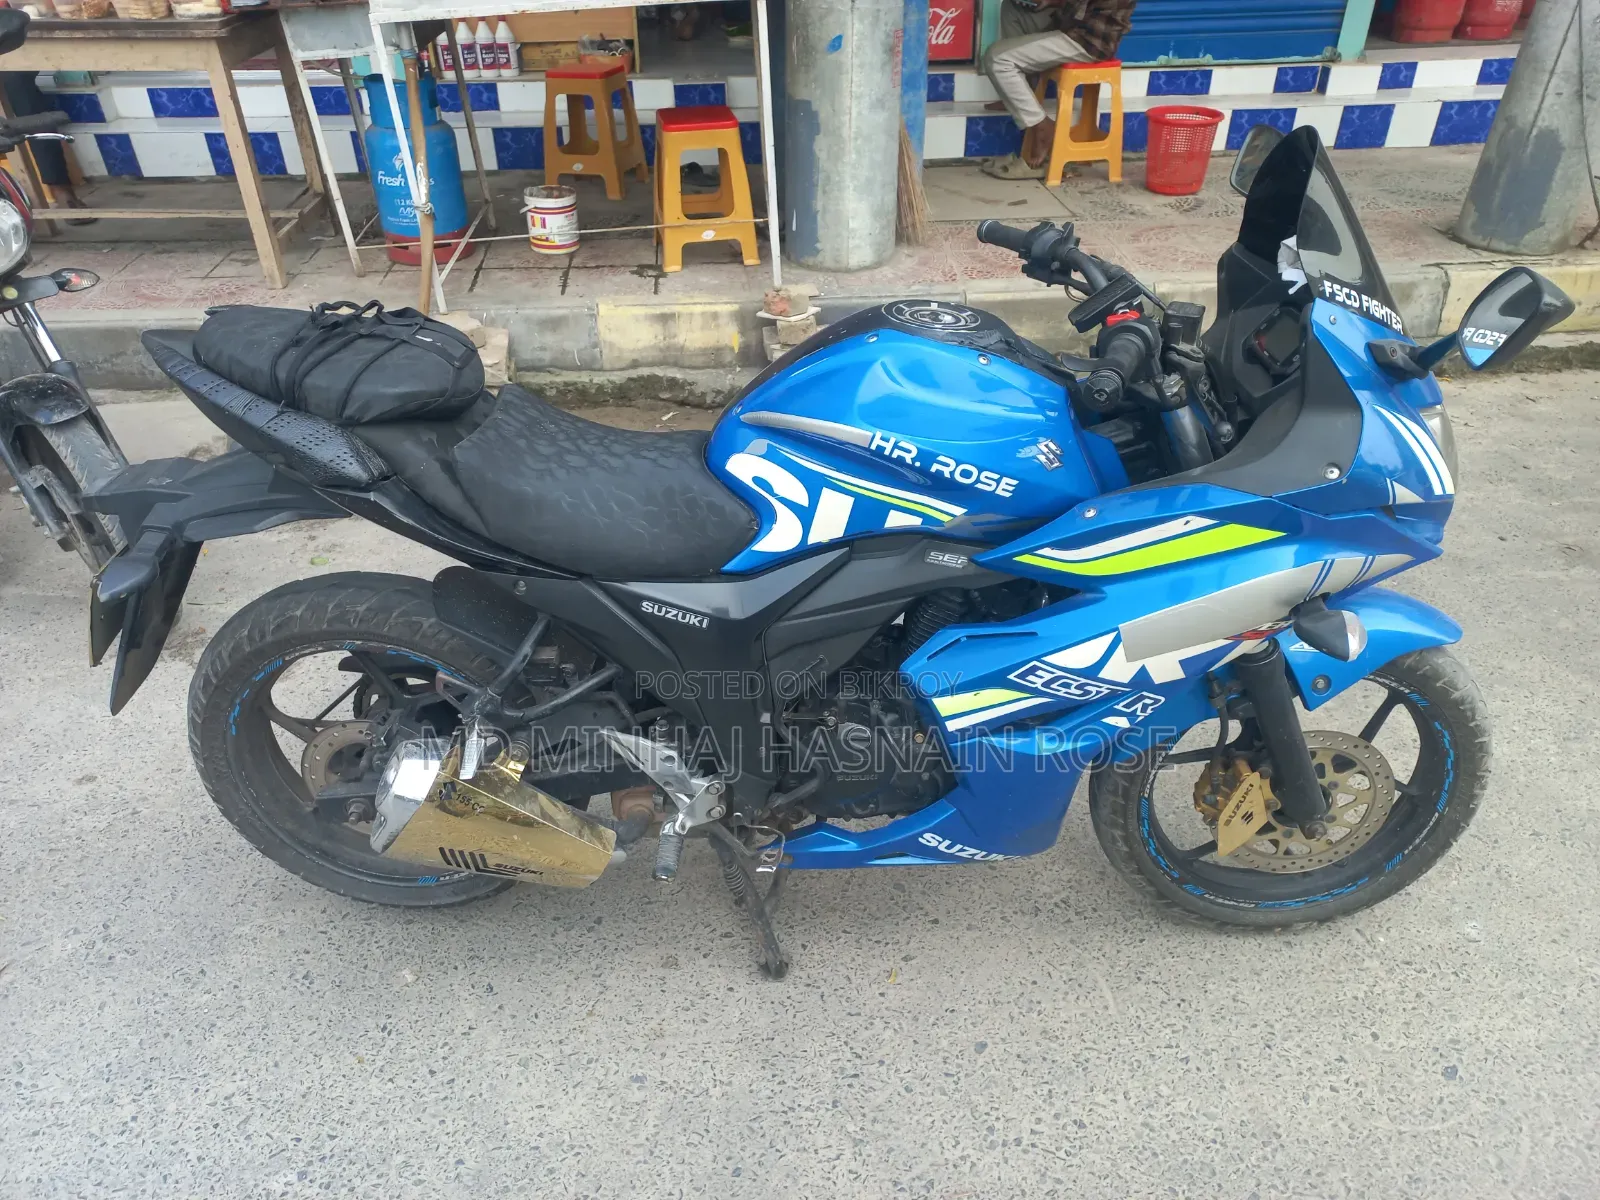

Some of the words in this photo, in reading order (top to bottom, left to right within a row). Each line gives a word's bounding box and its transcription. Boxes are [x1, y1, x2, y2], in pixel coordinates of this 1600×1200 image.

[928, 8, 962, 45] ola
[378, 171, 405, 187] Fresh
[1323, 280, 1359, 308] FSCD
[1361, 294, 1404, 335] FIGHTER
[870, 431, 920, 467] HR.
[930, 455, 1020, 498] ROSE
[640, 600, 709, 630] SUZUKI
[1006, 660, 1166, 717] ECSTR
[1223, 783, 1254, 827] SUZUKI
[493, 862, 545, 876] SUZUKI
